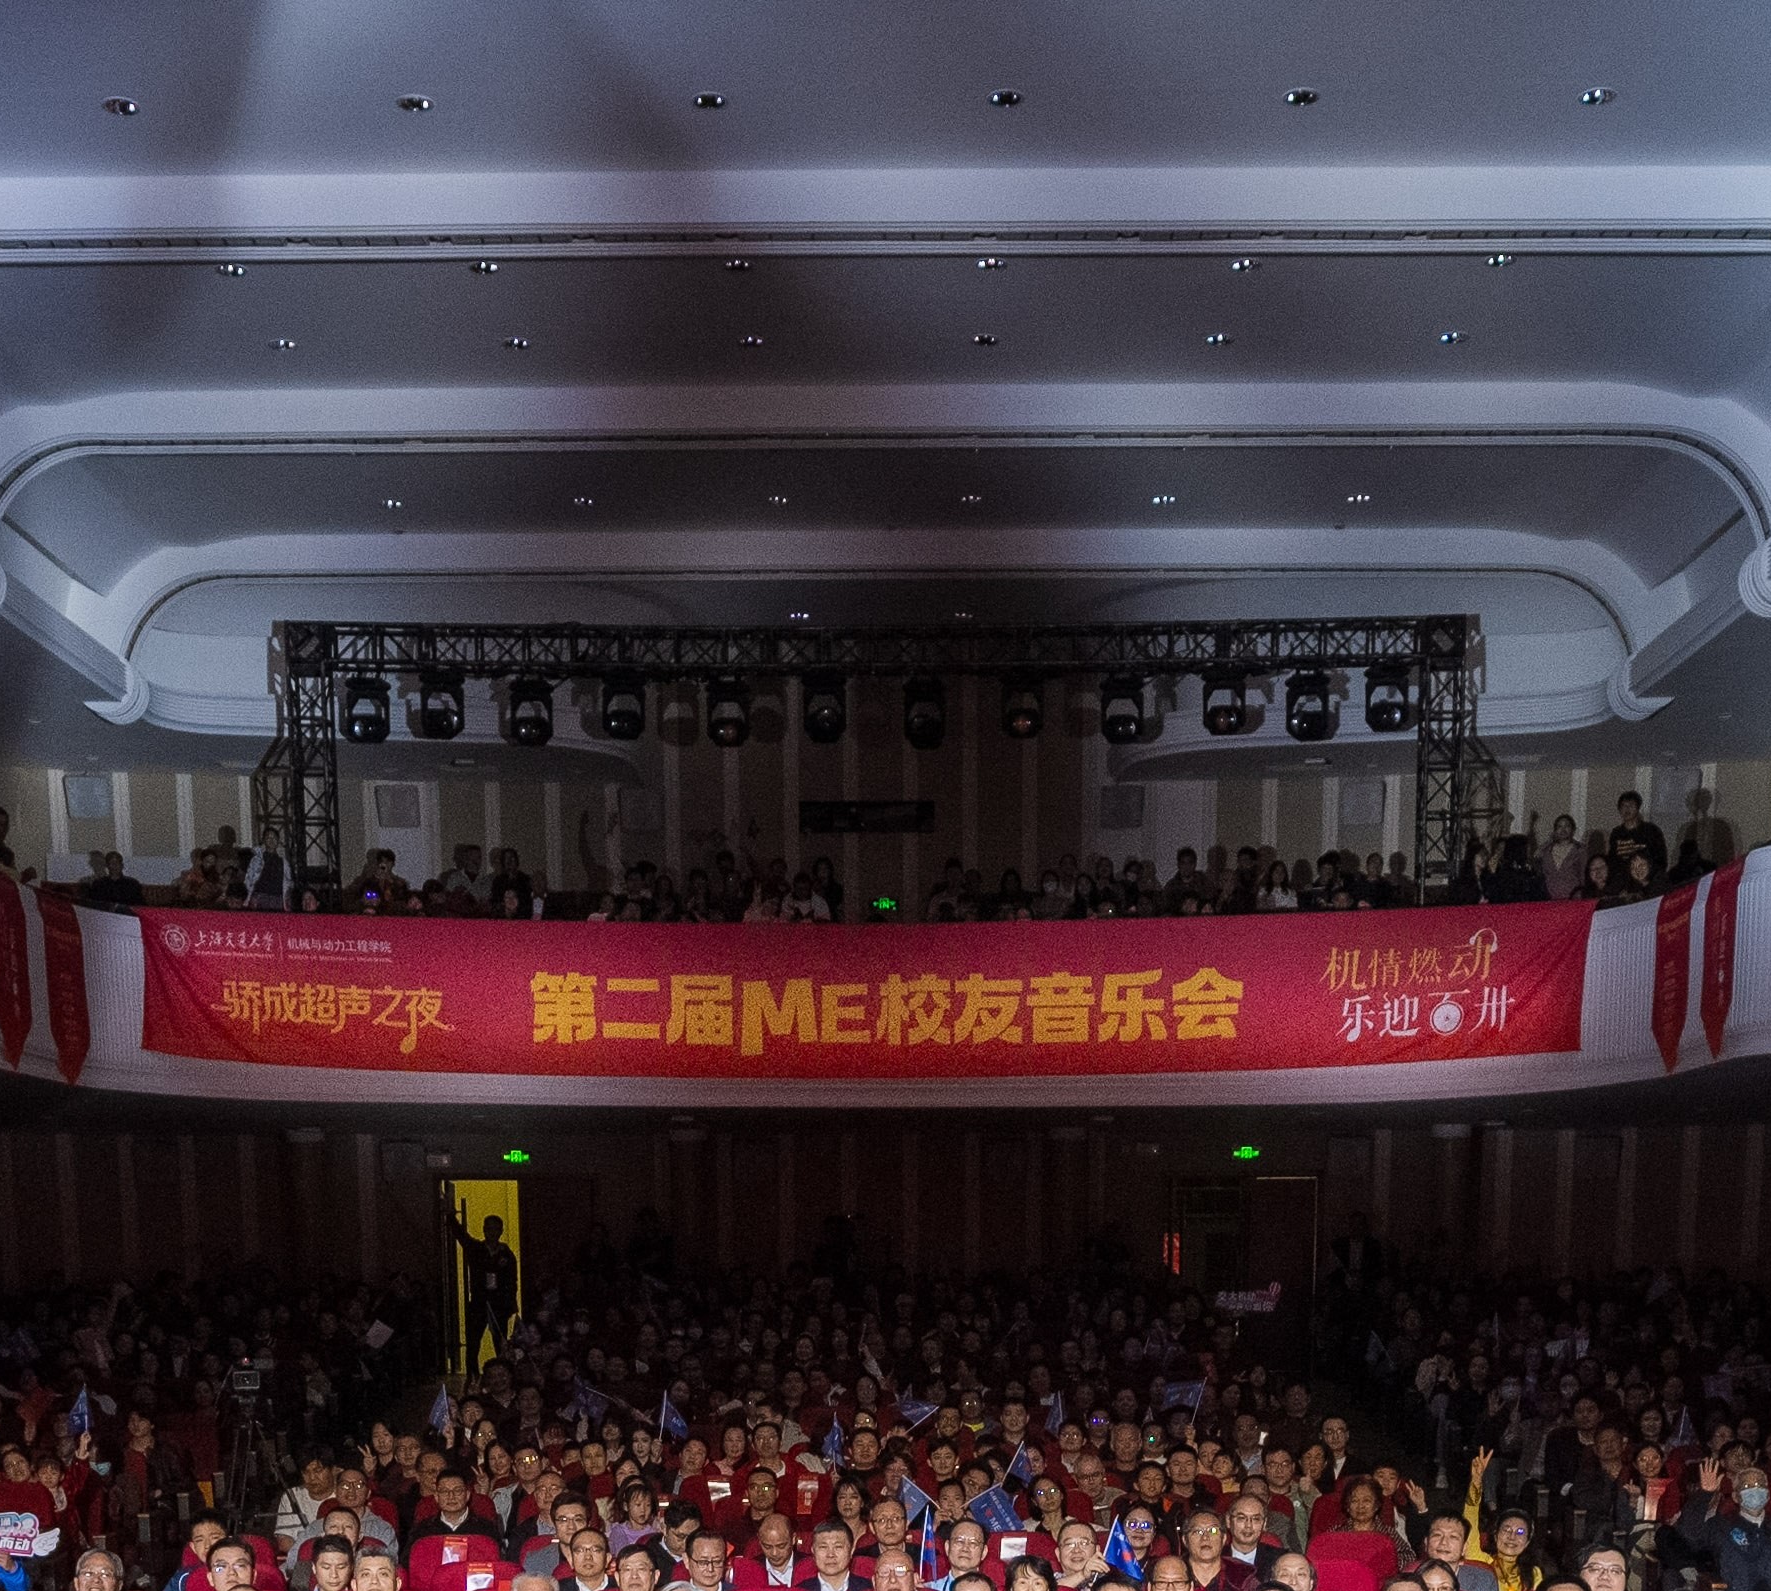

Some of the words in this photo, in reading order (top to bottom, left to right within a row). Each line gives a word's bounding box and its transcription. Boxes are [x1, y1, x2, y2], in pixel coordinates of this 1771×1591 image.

[1321, 928, 1499, 995] 机情燃动
[529, 965, 1245, 1057] 第二届ME校友音乐会
